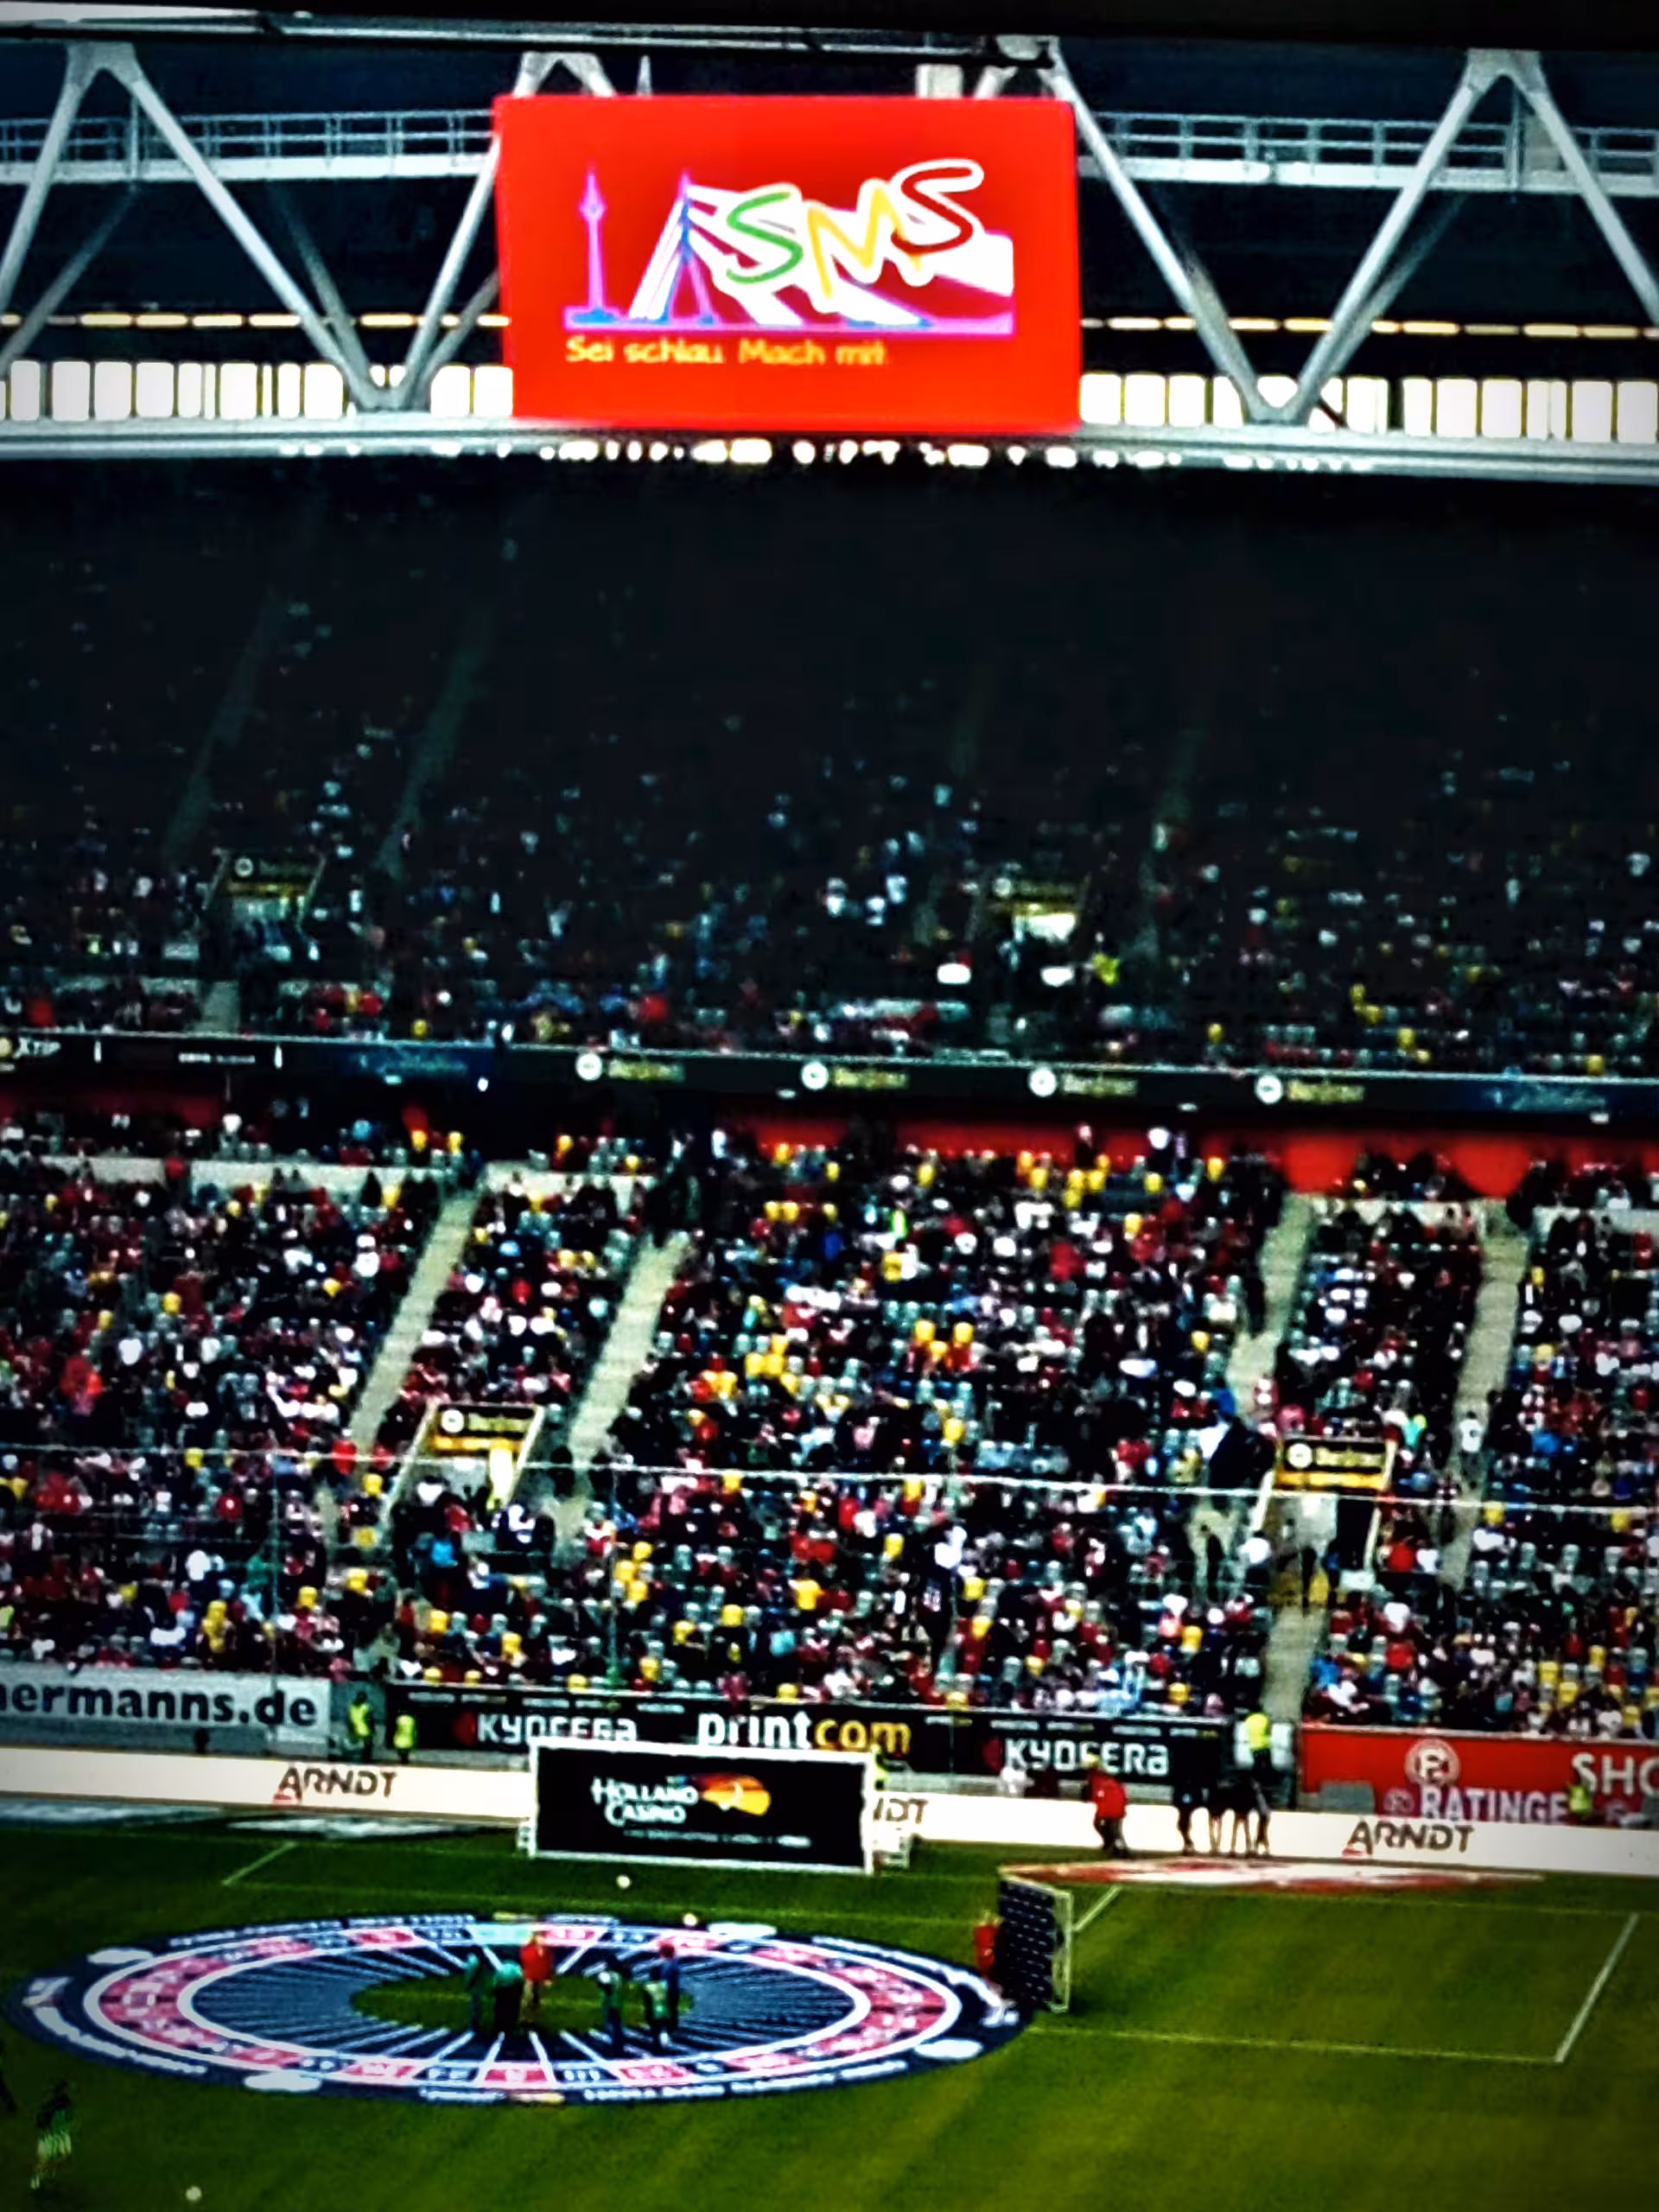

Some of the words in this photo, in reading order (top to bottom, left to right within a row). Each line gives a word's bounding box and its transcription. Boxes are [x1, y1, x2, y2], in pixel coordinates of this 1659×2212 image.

[722, 159, 985, 315] SMS
[566, 335, 613, 363] Sei
[739, 339, 825, 365] Mach
[836, 341, 886, 365] mit
[273, 1767, 397, 1802] ARNDT
[1342, 1821, 1475, 1855] ARNDT
